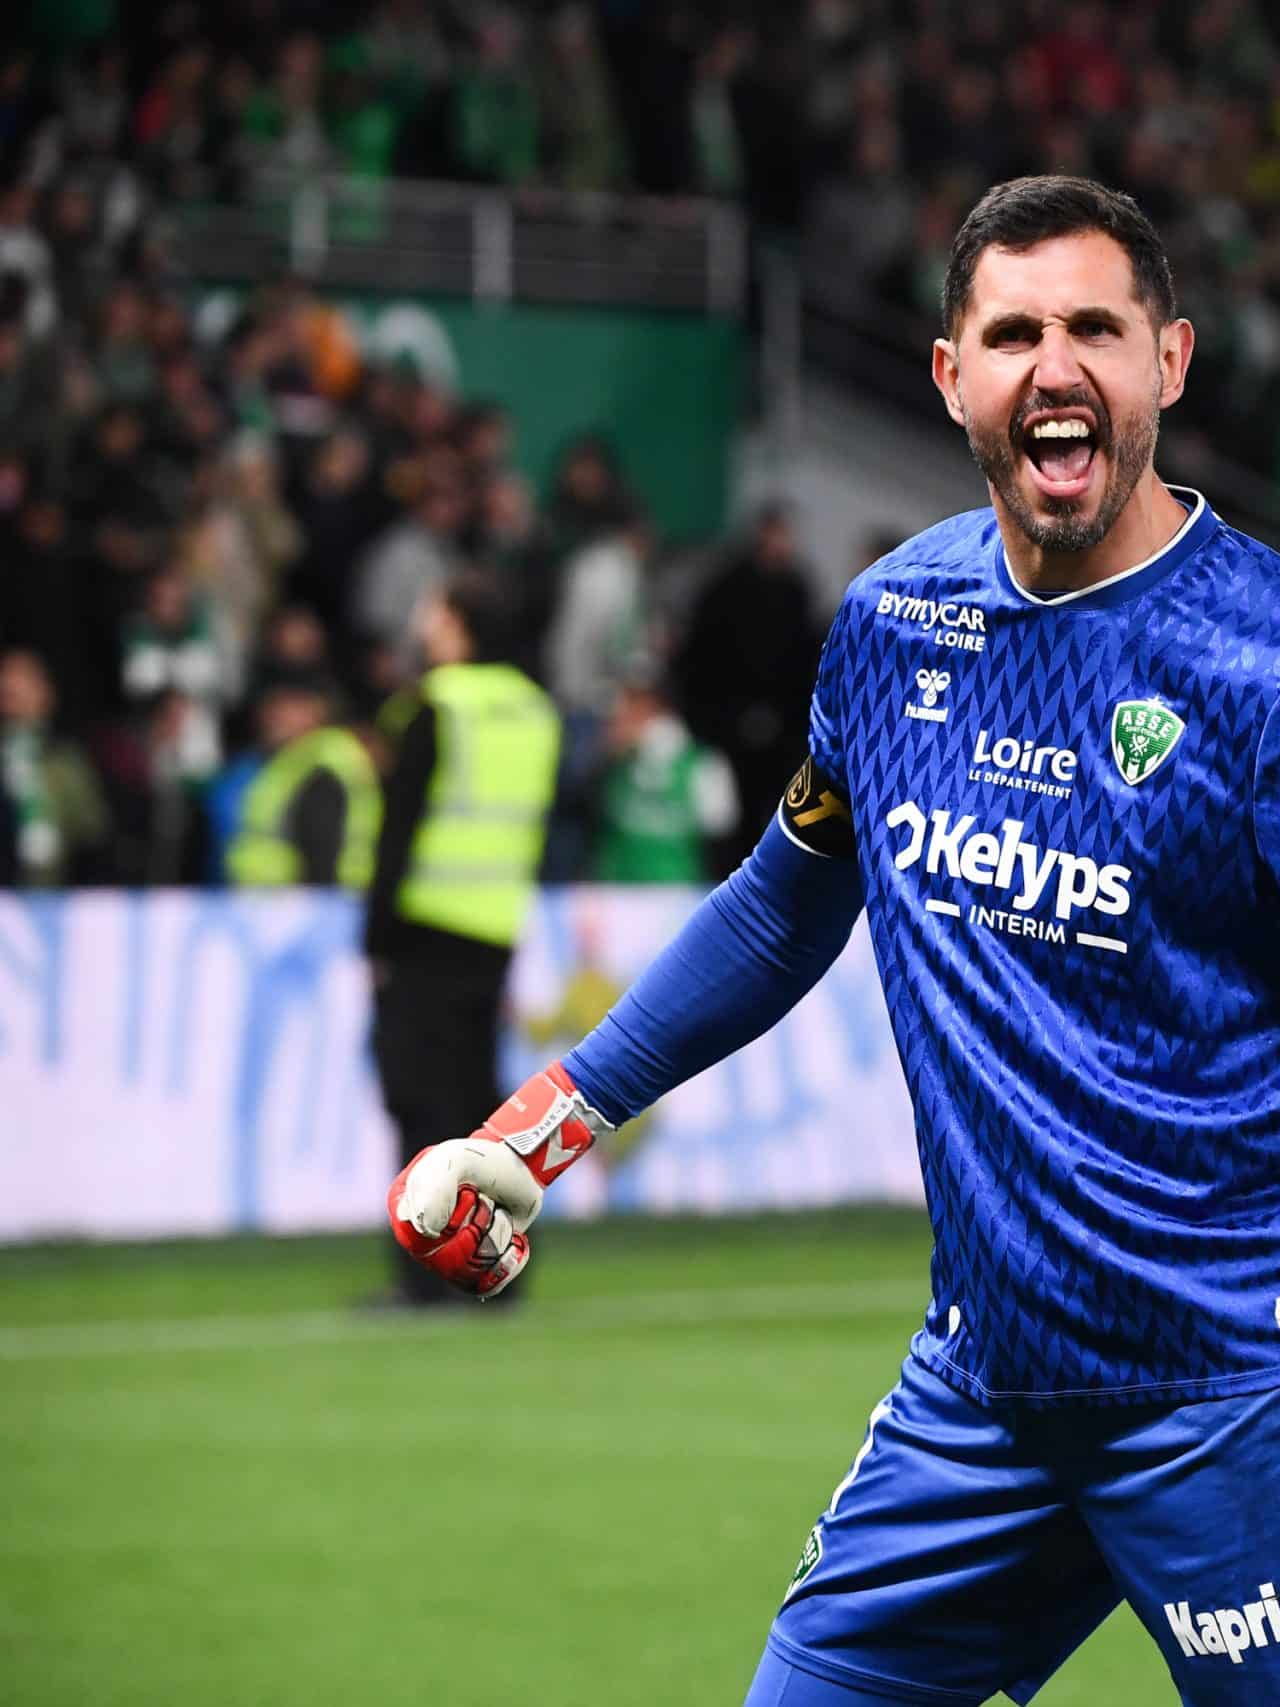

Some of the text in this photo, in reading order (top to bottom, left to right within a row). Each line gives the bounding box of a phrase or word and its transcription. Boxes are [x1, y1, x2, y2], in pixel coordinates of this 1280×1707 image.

[935, 629, 986, 652] LOIRE
[1121, 710, 1174, 739] ASSE
[973, 730, 1078, 781] Loire
[968, 769, 981, 781] LE
[926, 809, 1132, 920] Kelyps
[968, 904, 1067, 944] INTERIM
